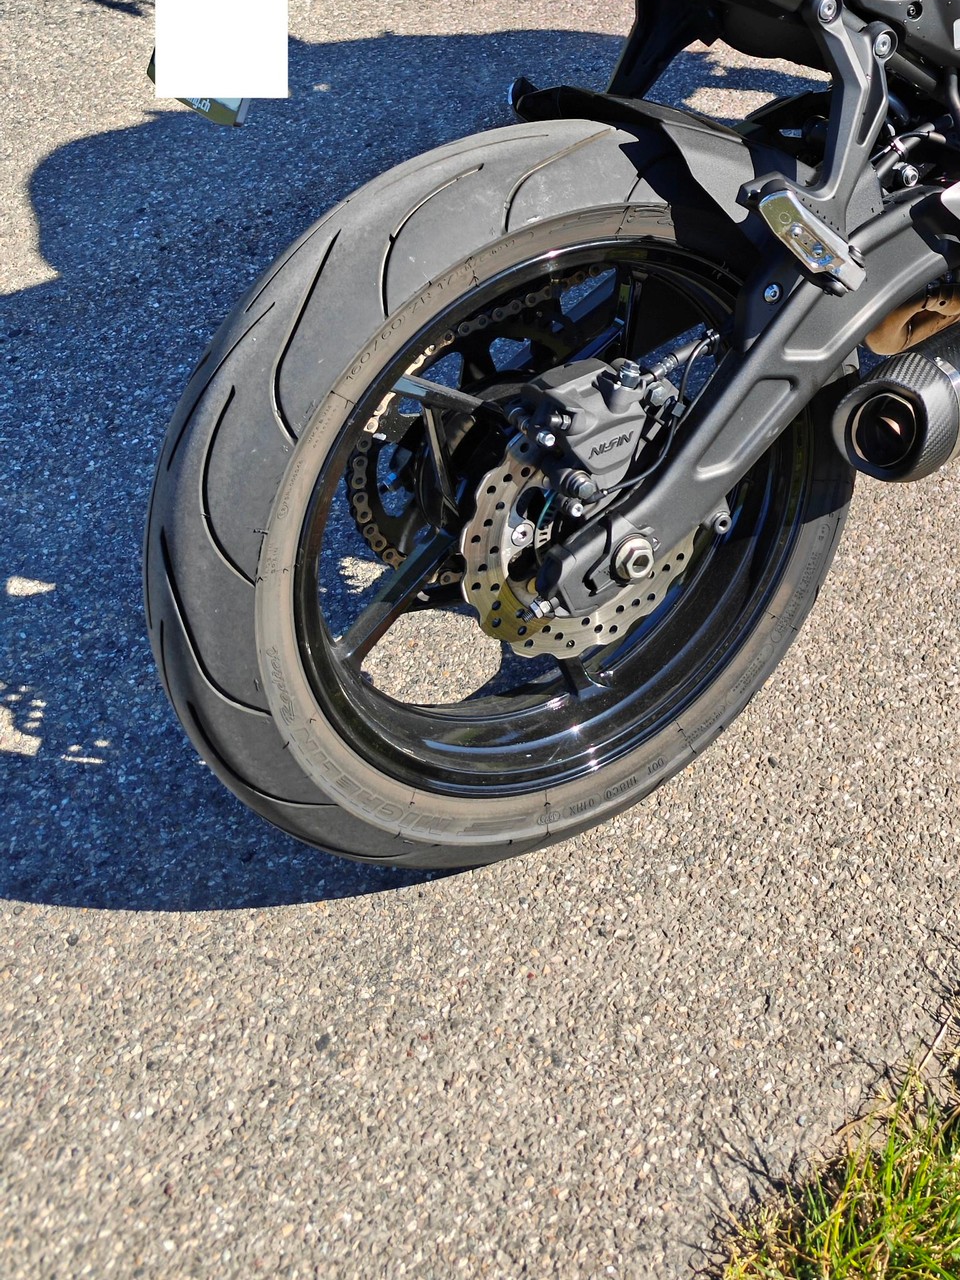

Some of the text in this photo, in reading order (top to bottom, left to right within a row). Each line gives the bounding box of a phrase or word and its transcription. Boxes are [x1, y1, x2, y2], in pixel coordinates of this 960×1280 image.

[588, 430, 634, 460] NISSIN
[294, 726, 455, 836] MICHELIN
[647, 757, 665, 776] DOT
